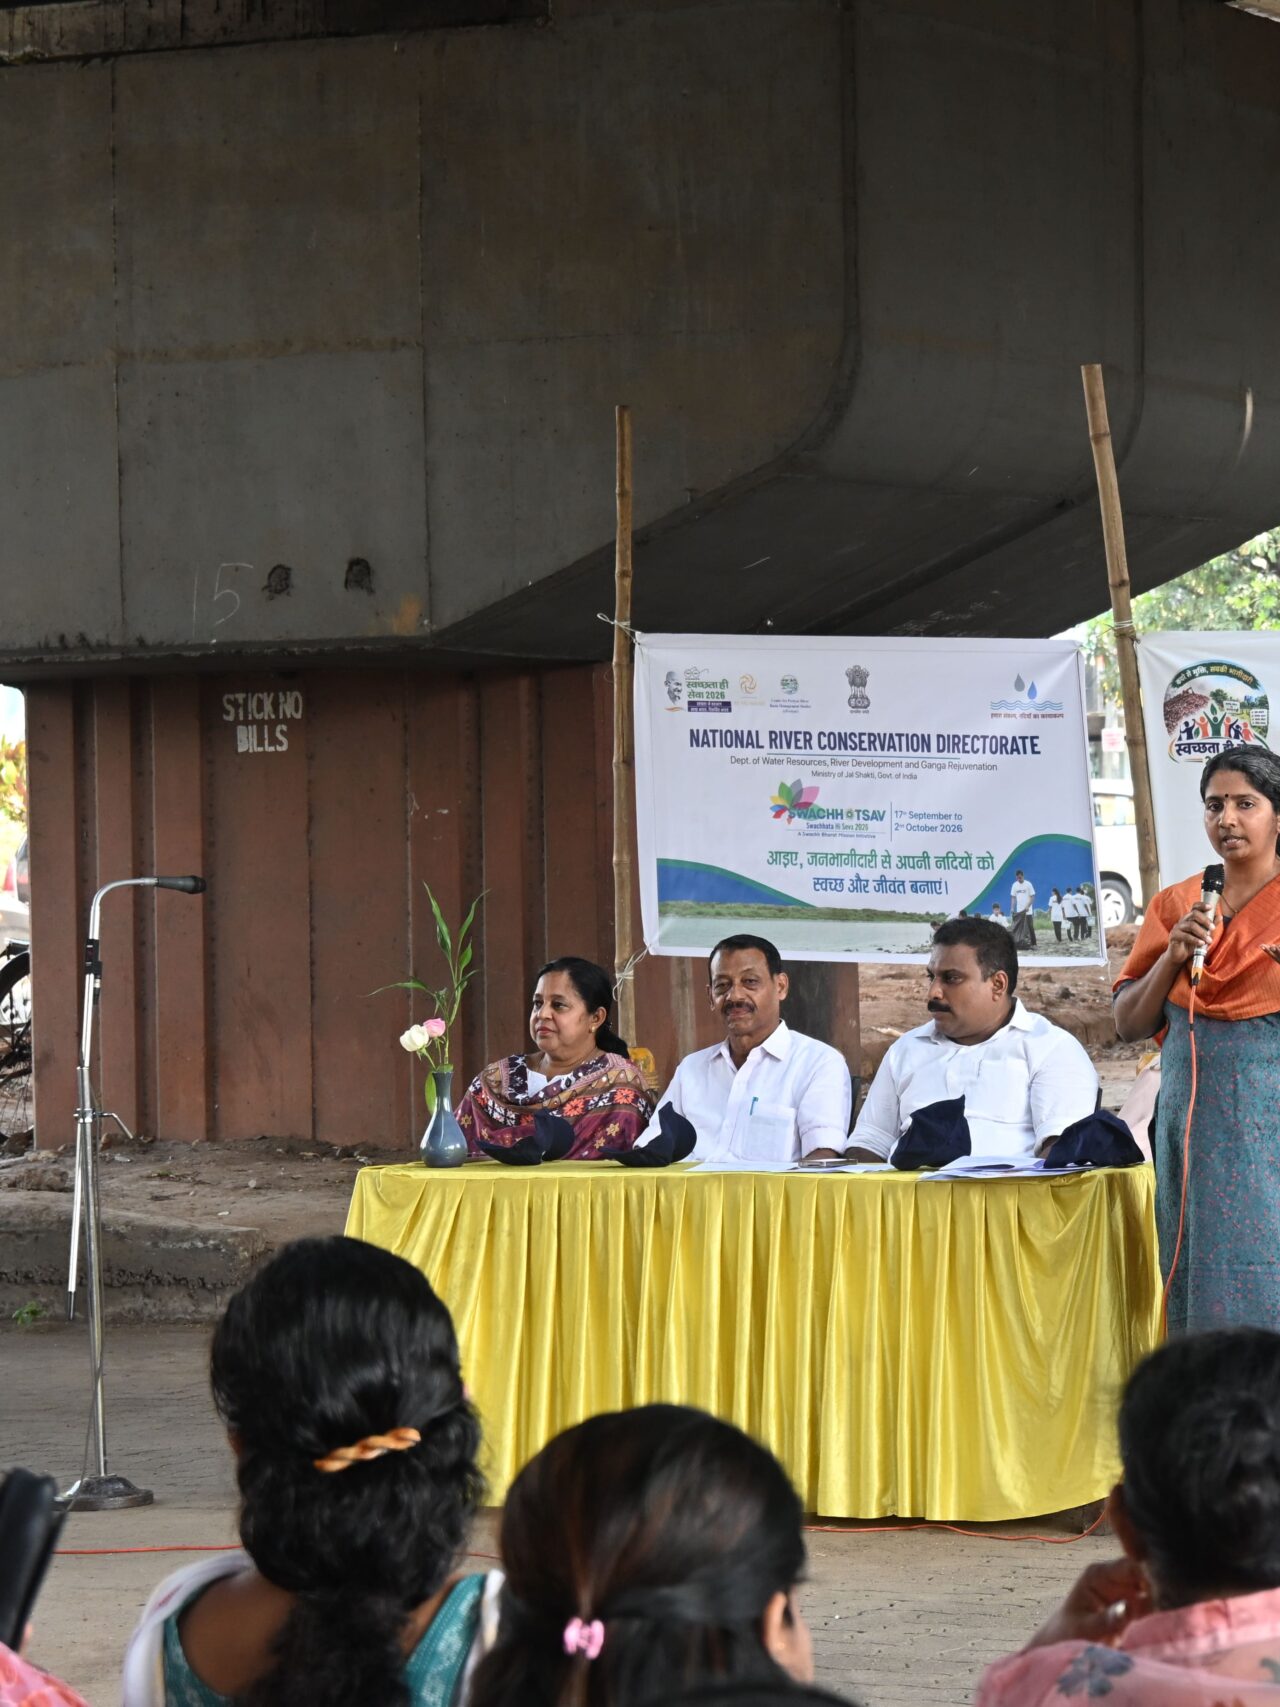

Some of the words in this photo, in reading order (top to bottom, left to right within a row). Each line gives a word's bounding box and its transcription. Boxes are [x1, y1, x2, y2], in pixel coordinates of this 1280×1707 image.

[686, 678, 718, 689] स्वच्छता
[719, 678, 729, 690] ही
[687, 690, 705, 700] सेवा
[706, 691, 726, 700] 2026
[222, 692, 276, 721] STICK
[278, 690, 303, 719] NO
[236, 724, 289, 753] BILLS
[689, 728, 765, 749] NATIONAL
[768, 730, 813, 750] RIVER
[817, 731, 931, 753] CONSERVATION
[936, 733, 1041, 755] DIRECTORATE
[1174, 742, 1220, 756] स्वच्छता
[730, 755, 750, 766] Dept.
[752, 756, 761, 765] of
[762, 756, 785, 766] Water
[787, 757, 829, 768] Resources,
[830, 758, 850, 767] River
[851, 759, 903, 770] Development
[904, 760, 920, 769] and
[921, 761, 947, 772] Ganga
[948, 761, 998, 772] Rejuvenation
[811, 770, 836, 779] Ministry
[837, 770, 844, 778] of
[855, 771, 876, 780] Shakti,
[908, 811, 953, 822] September
[954, 812, 963, 821] to
[806, 822, 834, 831] Swachhata
[906, 823, 938, 833] October
[940, 824, 963, 833] 2026
[767, 850, 803, 870] आइए,
[807, 848, 878, 869] जनभागीदारी
[881, 849, 892, 869] से
[896, 851, 931, 870] अपनी
[934, 851, 973, 871] नदियों
[976, 851, 995, 871] को
[813, 876, 844, 893] स्वच्छ
[847, 873, 869, 894] और
[873, 875, 906, 895] जीवंत
